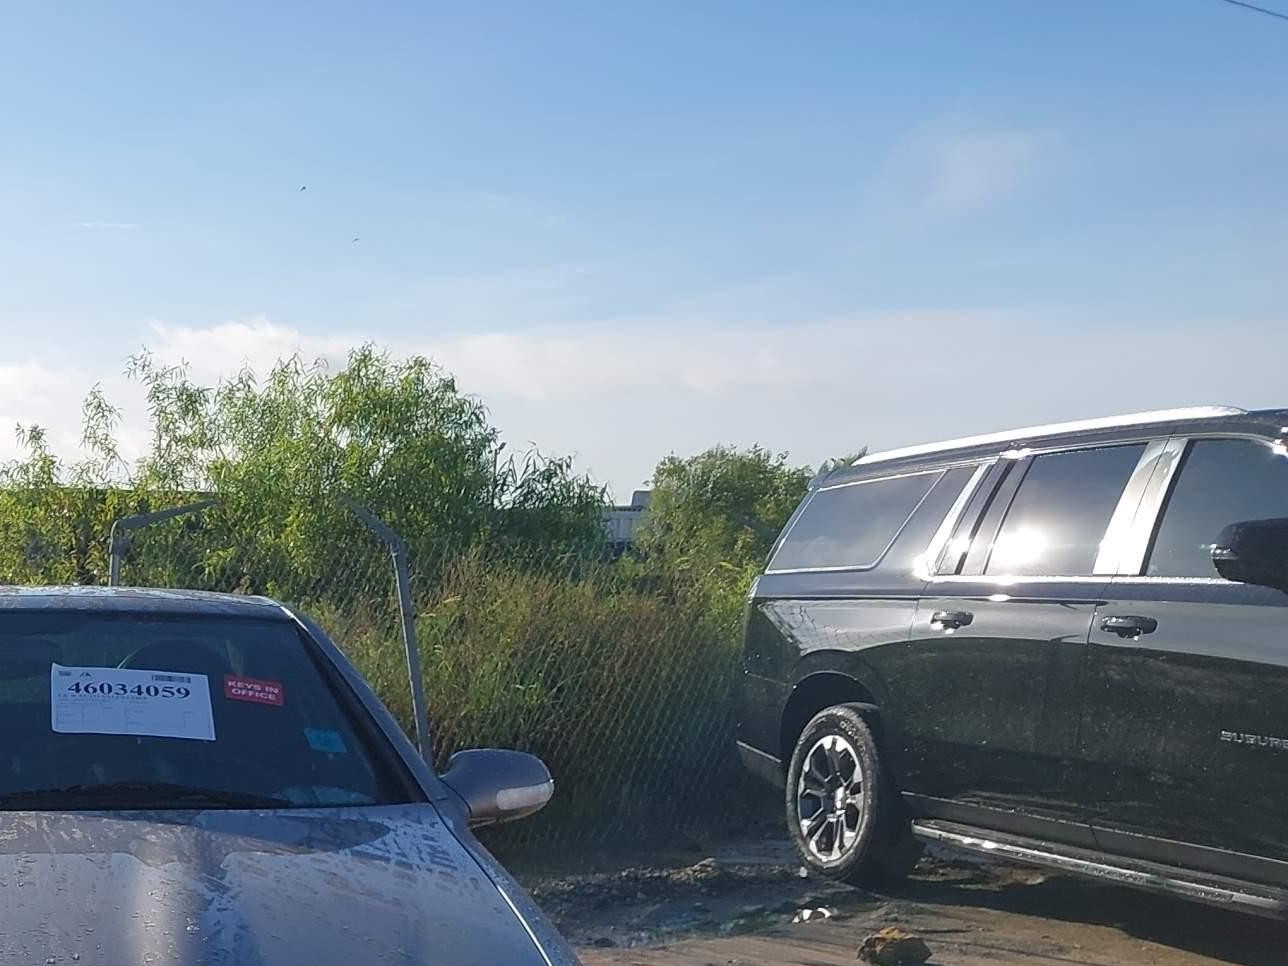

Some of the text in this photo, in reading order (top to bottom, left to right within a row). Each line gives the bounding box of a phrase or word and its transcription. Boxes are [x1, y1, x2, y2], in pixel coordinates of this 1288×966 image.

[67, 681, 191, 700] 46034059
[227, 680, 279, 694] KEYS IN
[231, 688, 276, 700] OFFICE
